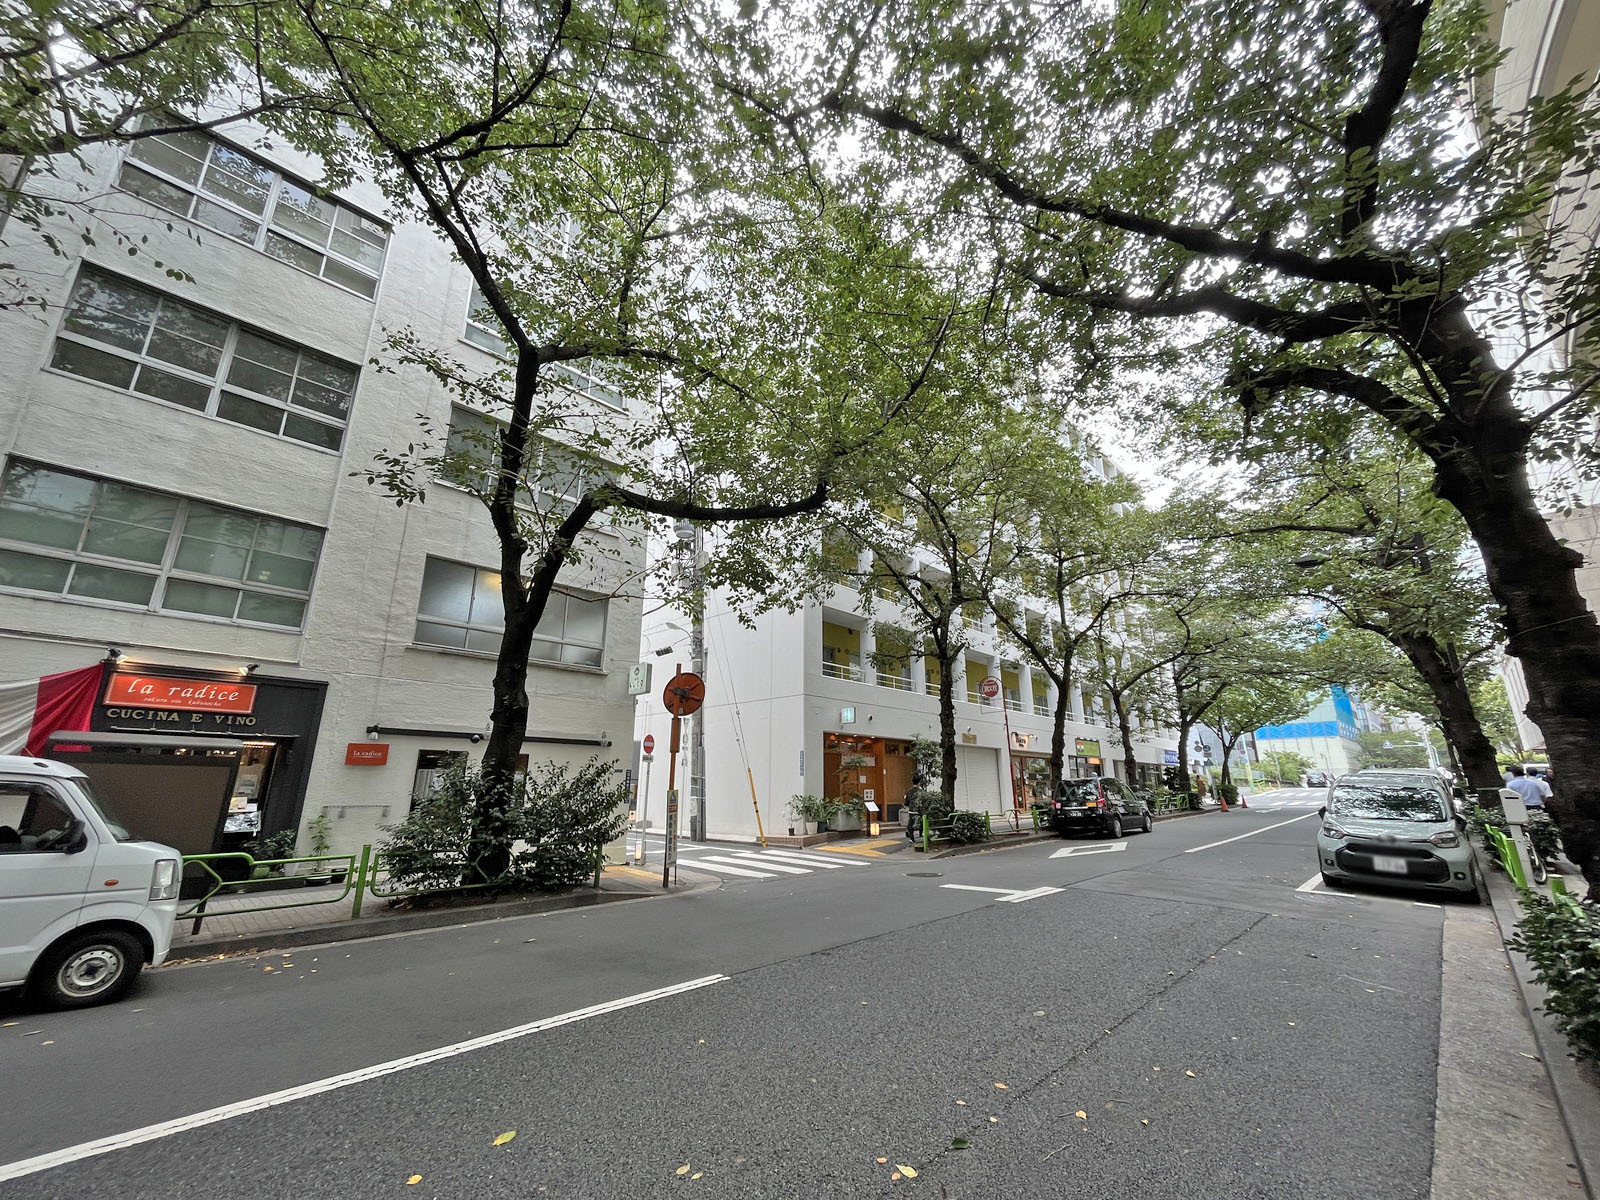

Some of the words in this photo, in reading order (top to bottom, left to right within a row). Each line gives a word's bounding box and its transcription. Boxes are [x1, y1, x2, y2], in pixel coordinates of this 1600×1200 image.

[127, 678, 154, 695] la
[168, 684, 240, 701] radice
[106, 708, 181, 722] CUCINA
[191, 713, 204, 723] E
[214, 715, 257, 726] VINO
